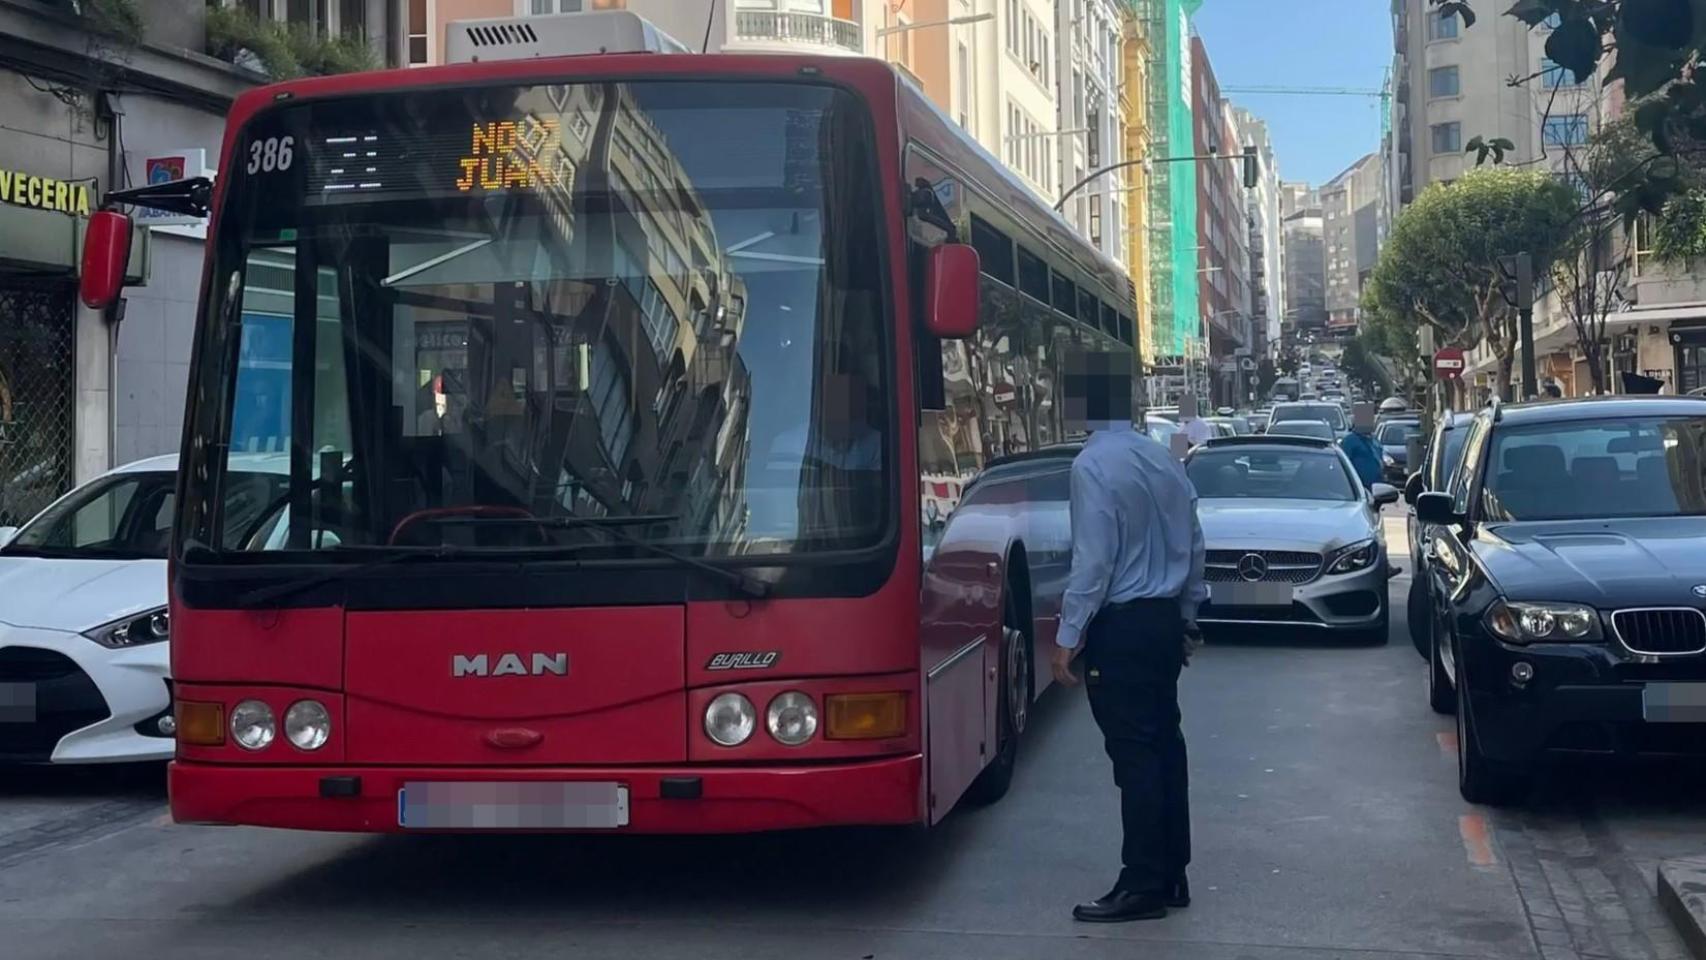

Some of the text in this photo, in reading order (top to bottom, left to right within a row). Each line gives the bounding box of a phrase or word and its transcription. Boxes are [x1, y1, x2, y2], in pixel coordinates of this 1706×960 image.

[247, 136, 295, 175] 386
[453, 652, 567, 677] MAN
[707, 651, 778, 670] BURILLO
